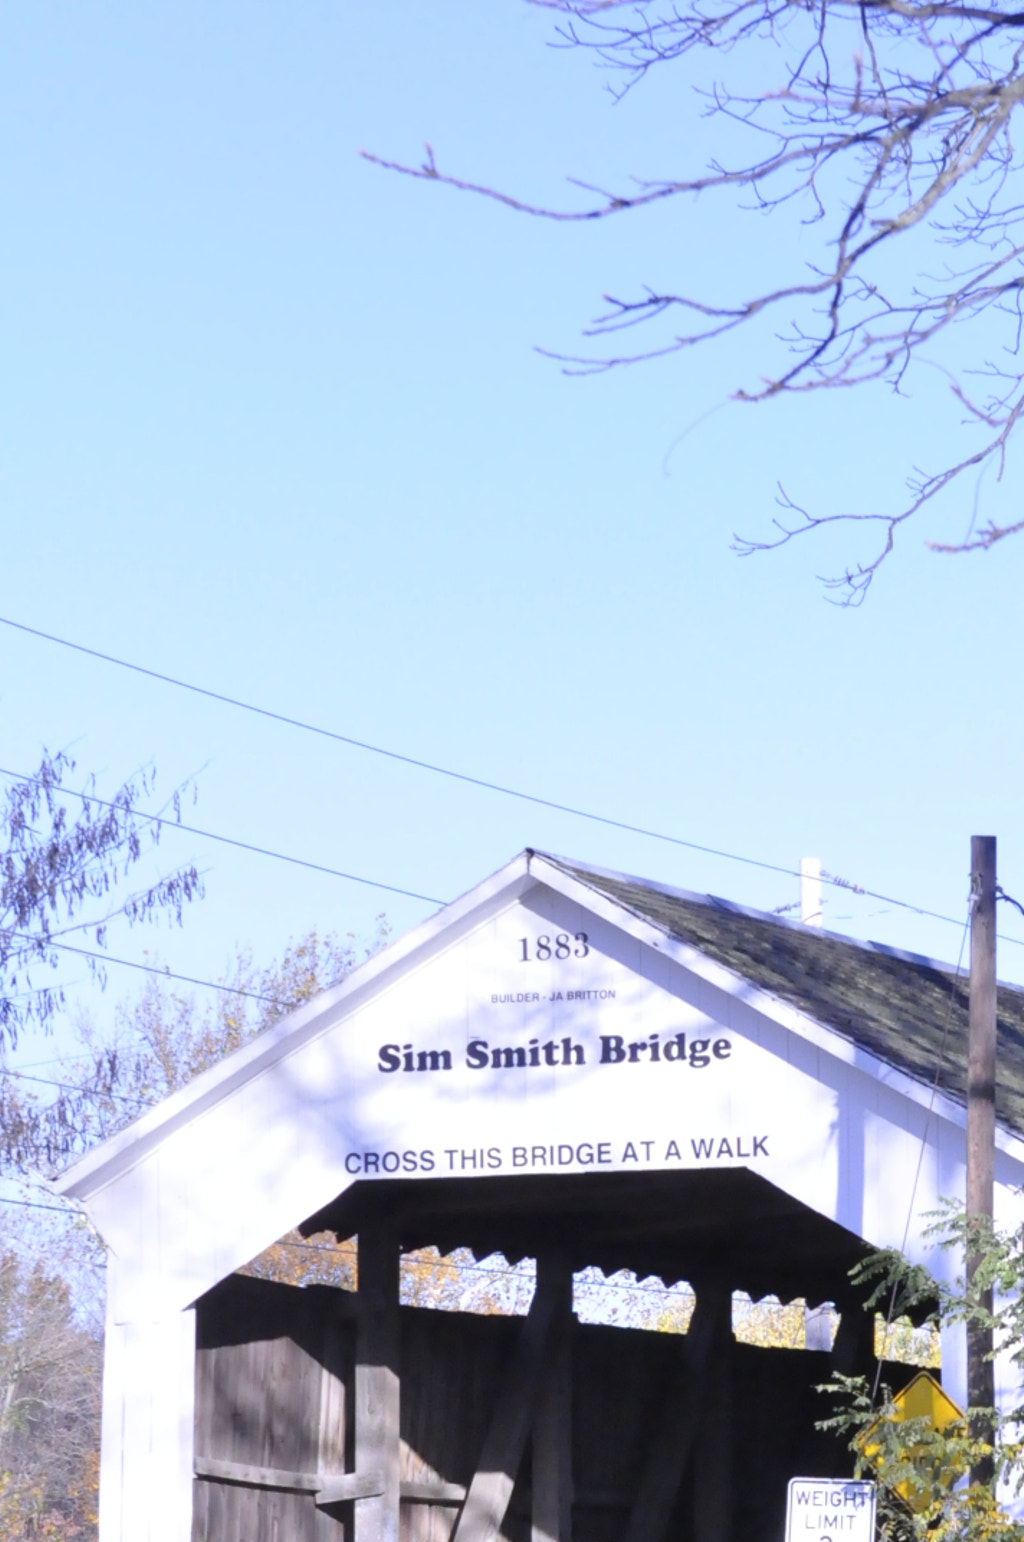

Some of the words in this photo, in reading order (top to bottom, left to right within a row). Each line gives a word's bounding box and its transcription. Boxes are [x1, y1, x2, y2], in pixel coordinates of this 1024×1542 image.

[518, 932, 589, 962] 1883
[491, 992, 540, 1003] BUILDER
[566, 990, 616, 1001] BRITTON
[378, 1044, 452, 1073] Sim
[466, 1037, 586, 1069] Smith
[599, 1033, 732, 1068] Bridge
[344, 1150, 435, 1174] CROSS
[444, 1147, 502, 1170] THIS
[512, 1143, 612, 1167] BRIDGE
[621, 1141, 655, 1163] AT
[665, 1140, 682, 1161] A
[691, 1136, 770, 1159] WALK
[796, 1490, 868, 1507] WEIGHT
[805, 1514, 857, 1530] LIMIT
